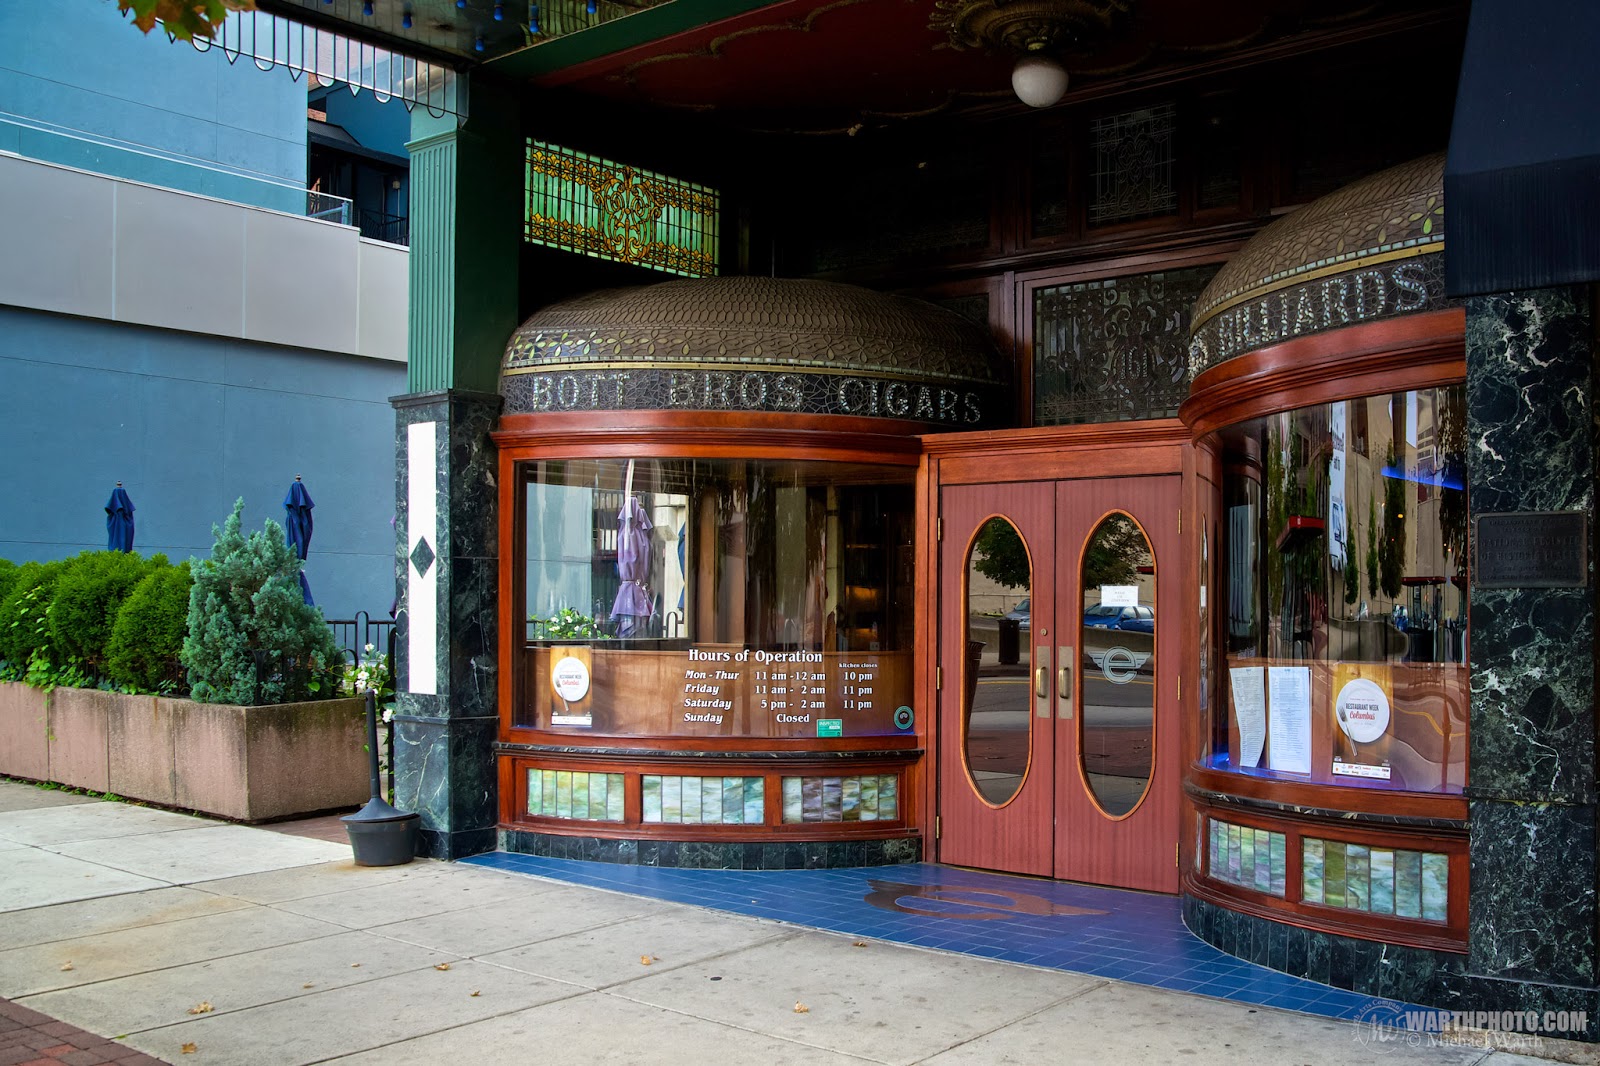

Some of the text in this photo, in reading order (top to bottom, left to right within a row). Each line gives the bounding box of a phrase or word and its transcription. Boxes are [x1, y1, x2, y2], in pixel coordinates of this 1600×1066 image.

[1218, 262, 1427, 357] BILLIARDS
[533, 372, 981, 423] BOTT BROS CIGARS
[688, 649, 823, 666] Hours of Operation
[685, 670, 707, 680] Mon
[715, 671, 740, 680] Thur
[755, 672, 767, 681] 11
[771, 672, 787, 681] am
[810, 673, 826, 681] am
[844, 672, 856, 681] 10
[858, 673, 873, 683] pm
[684, 684, 720, 696] Friday
[755, 685, 767, 694] 11
[771, 686, 787, 695] am
[801, 686, 807, 695] 2
[810, 687, 826, 695] am
[843, 686, 854, 695] 11
[858, 687, 873, 697] pm
[683, 698, 732, 711] Saturday
[760, 700, 767, 709] 5
[770, 701, 787, 711] pm
[801, 700, 807, 709] 2
[810, 701, 826, 709] am
[843, 700, 854, 709] 11
[858, 701, 872, 711] pm
[1345, 702, 1368, 711] RESTAURANT
[683, 712, 810, 725] Sunday Closed
[1349, 711, 1375, 720] Columbus
